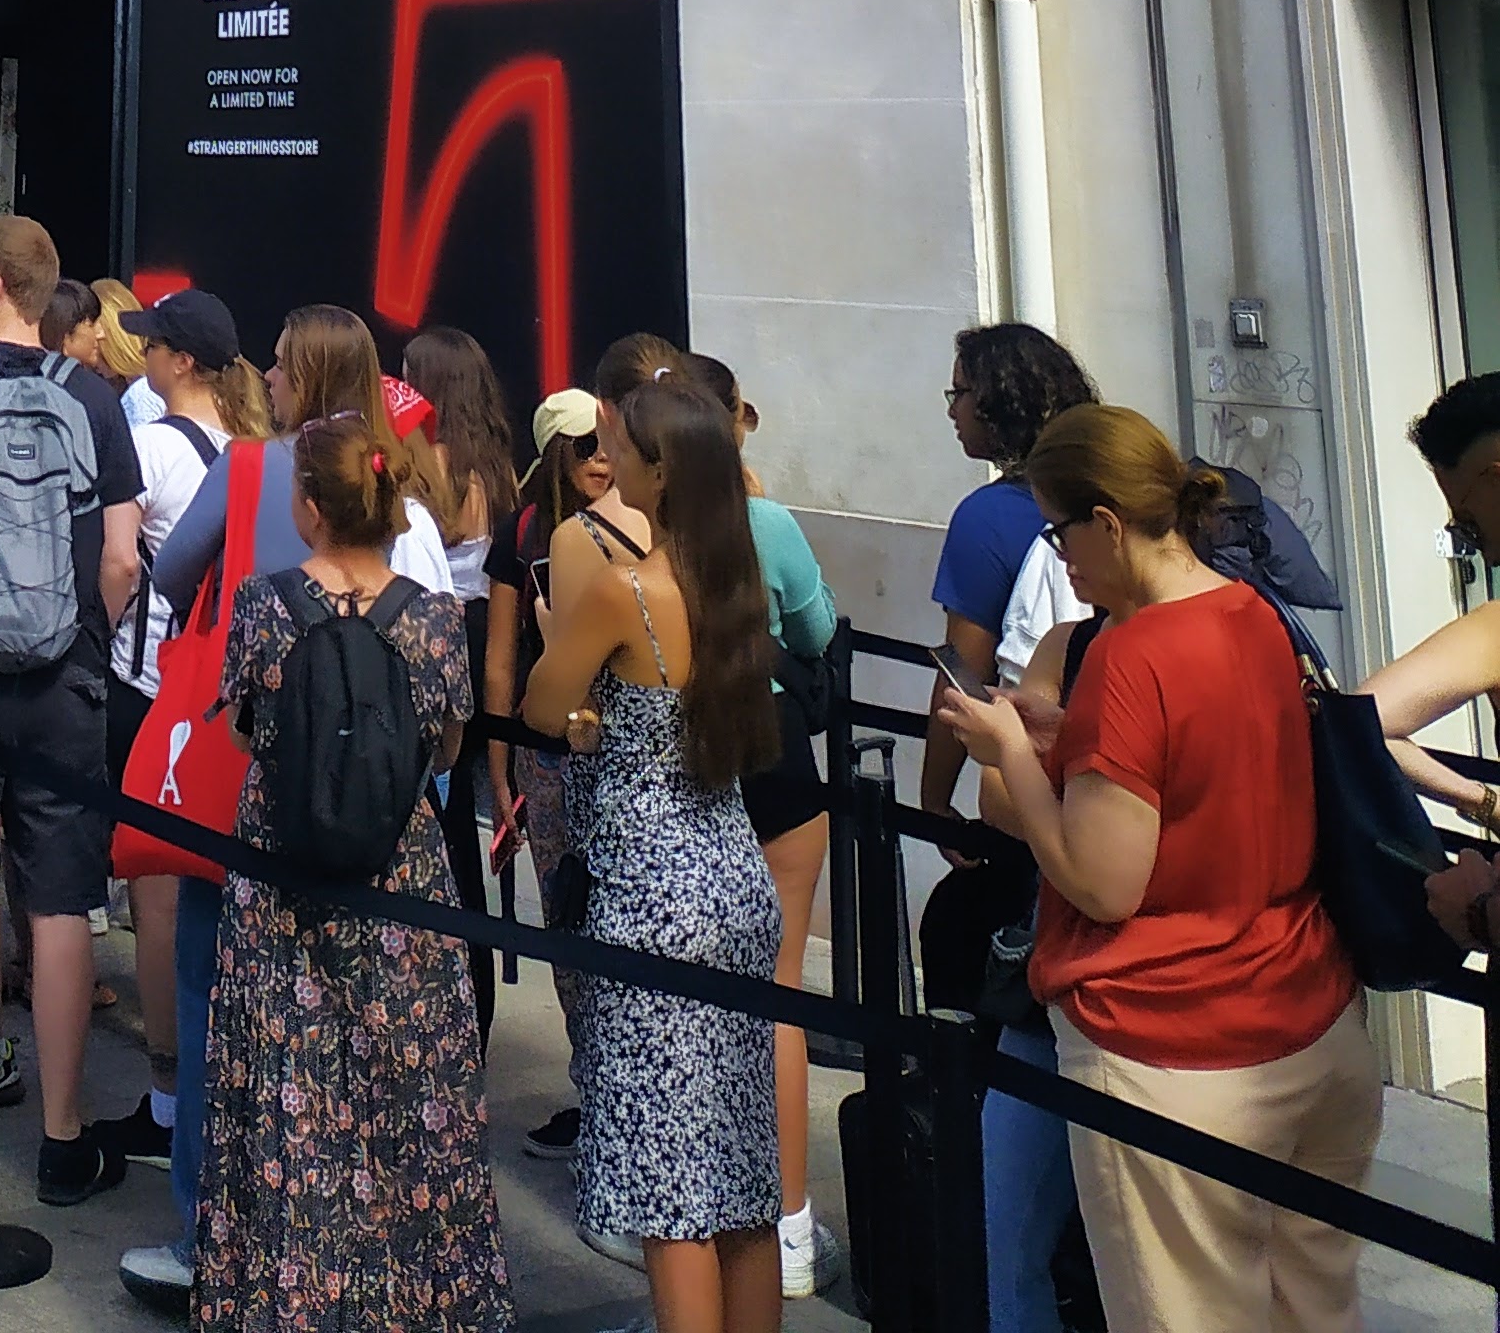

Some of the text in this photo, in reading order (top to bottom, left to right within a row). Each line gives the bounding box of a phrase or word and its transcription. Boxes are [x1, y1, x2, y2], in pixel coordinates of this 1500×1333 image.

[217, 0, 290, 38] LIMITÉE
[206, 67, 299, 86] OPEN NOW FOR
[209, 90, 295, 109] A LIMITED TIME
[187, 139, 319, 156] #STRANGERTHINGSSTORE
